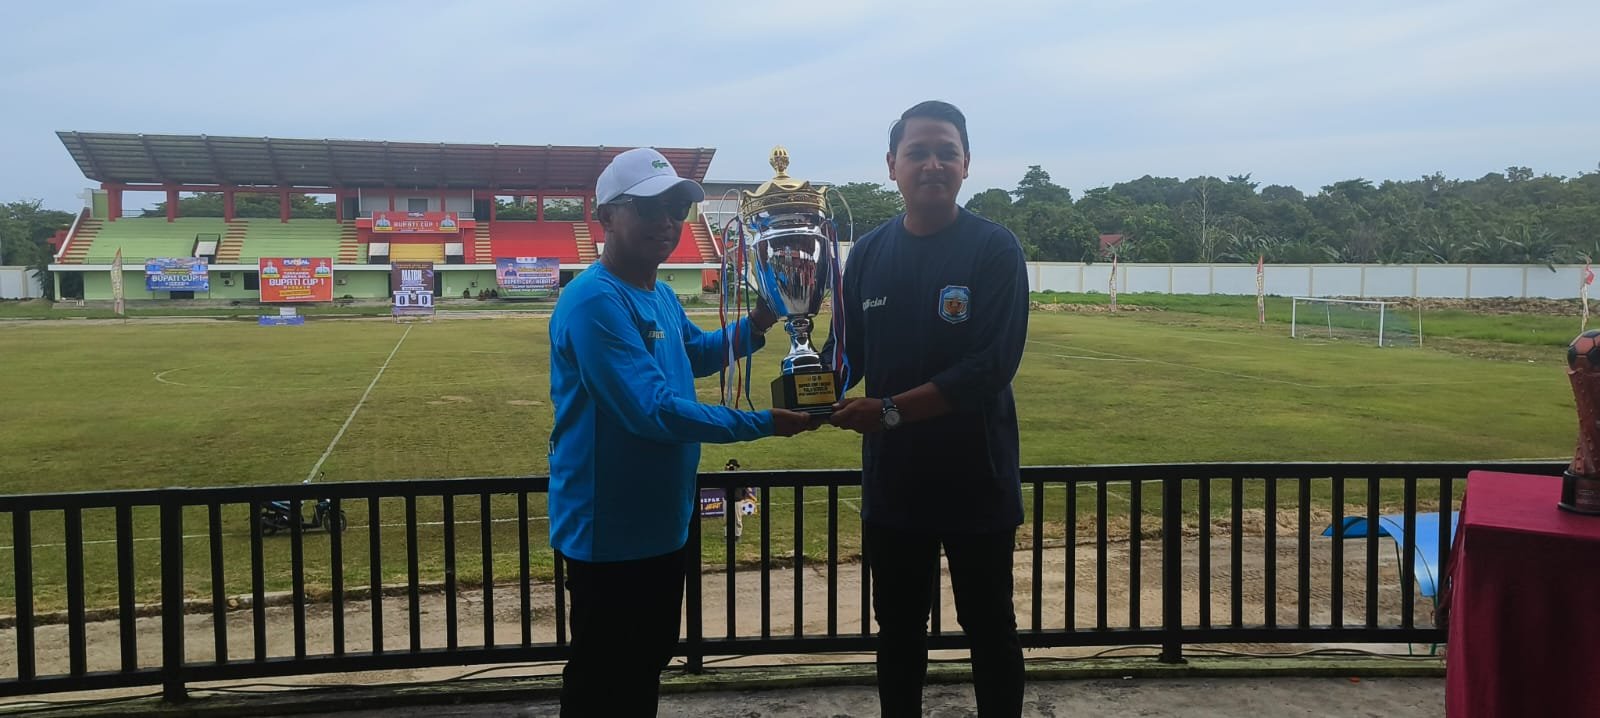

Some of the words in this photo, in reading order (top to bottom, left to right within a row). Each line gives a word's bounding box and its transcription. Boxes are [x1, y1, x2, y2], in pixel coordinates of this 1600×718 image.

[151, 274, 180, 282] BUPATI
[181, 274, 198, 282] CUP
[269, 278, 301, 286] BUPATI
[302, 278, 319, 286] CUP
[399, 295, 406, 305] 0
[421, 295, 428, 305] 0
